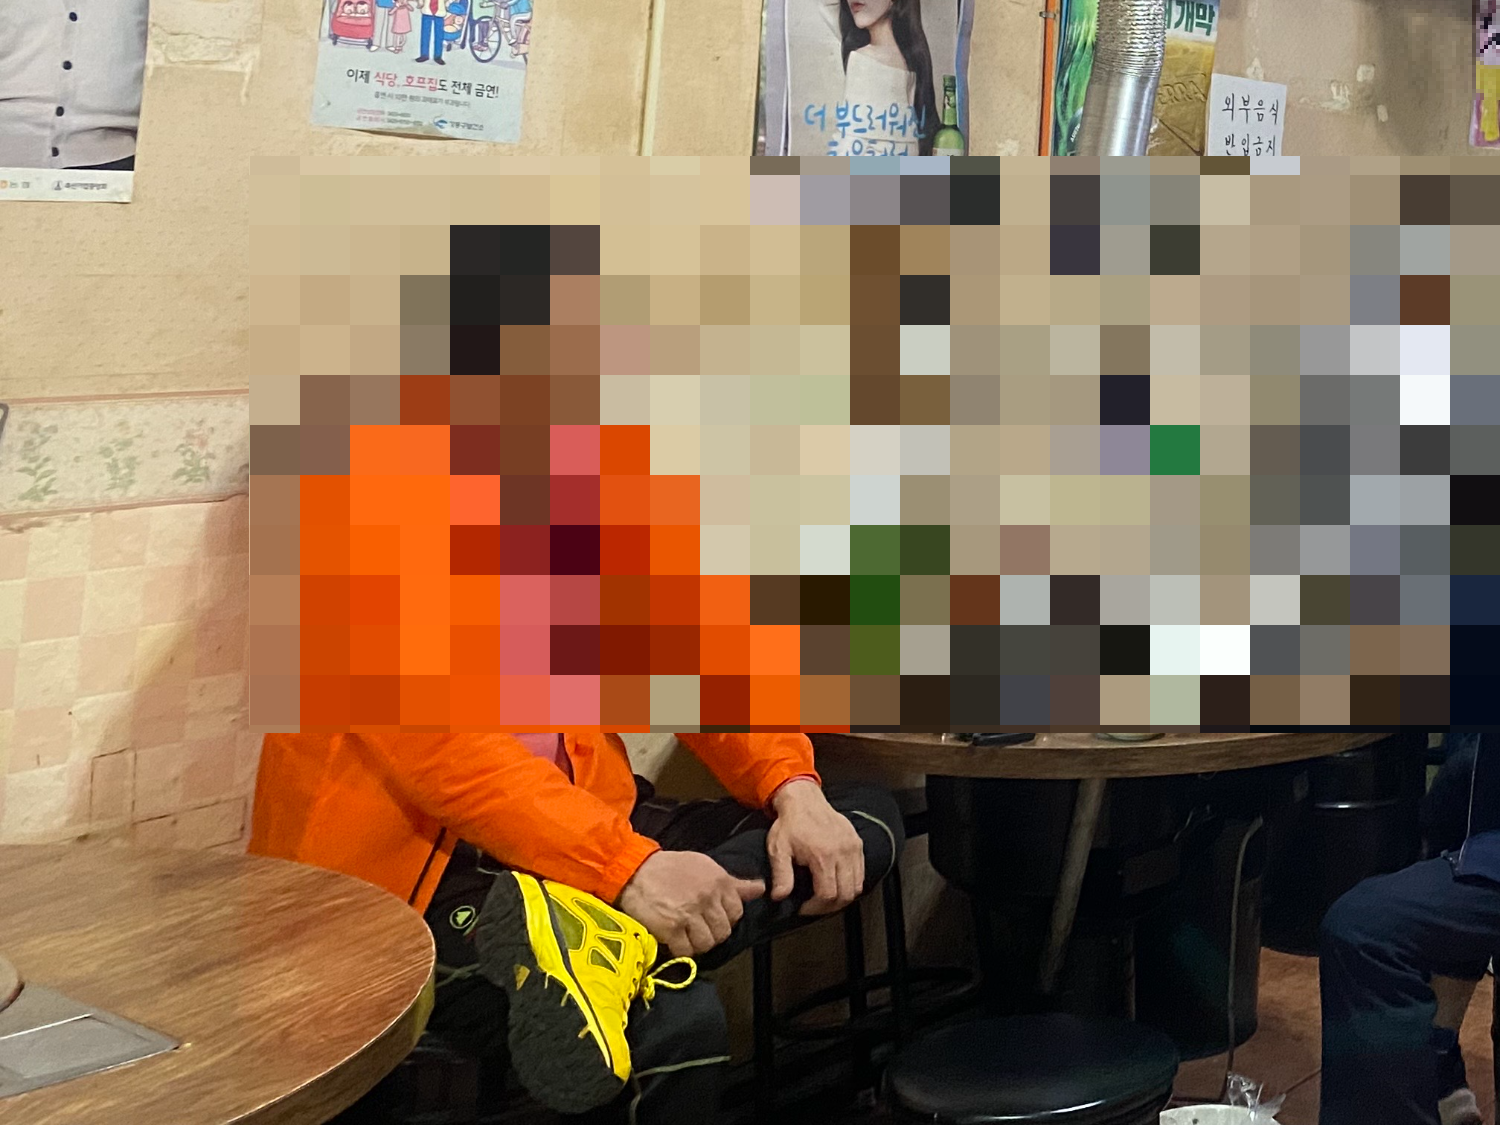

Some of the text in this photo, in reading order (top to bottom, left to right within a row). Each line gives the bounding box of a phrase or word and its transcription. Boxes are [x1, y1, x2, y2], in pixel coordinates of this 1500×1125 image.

[346, 68, 371, 84] 이제
[402, 75, 448, 92] 호프집도
[450, 79, 472, 96] 전체
[474, 83, 499, 99] 금연!
[804, 99, 927, 139] 더 부드러워진
[1222, 92, 1279, 125] 외부음식
[1224, 133, 1276, 156] 반입금지
